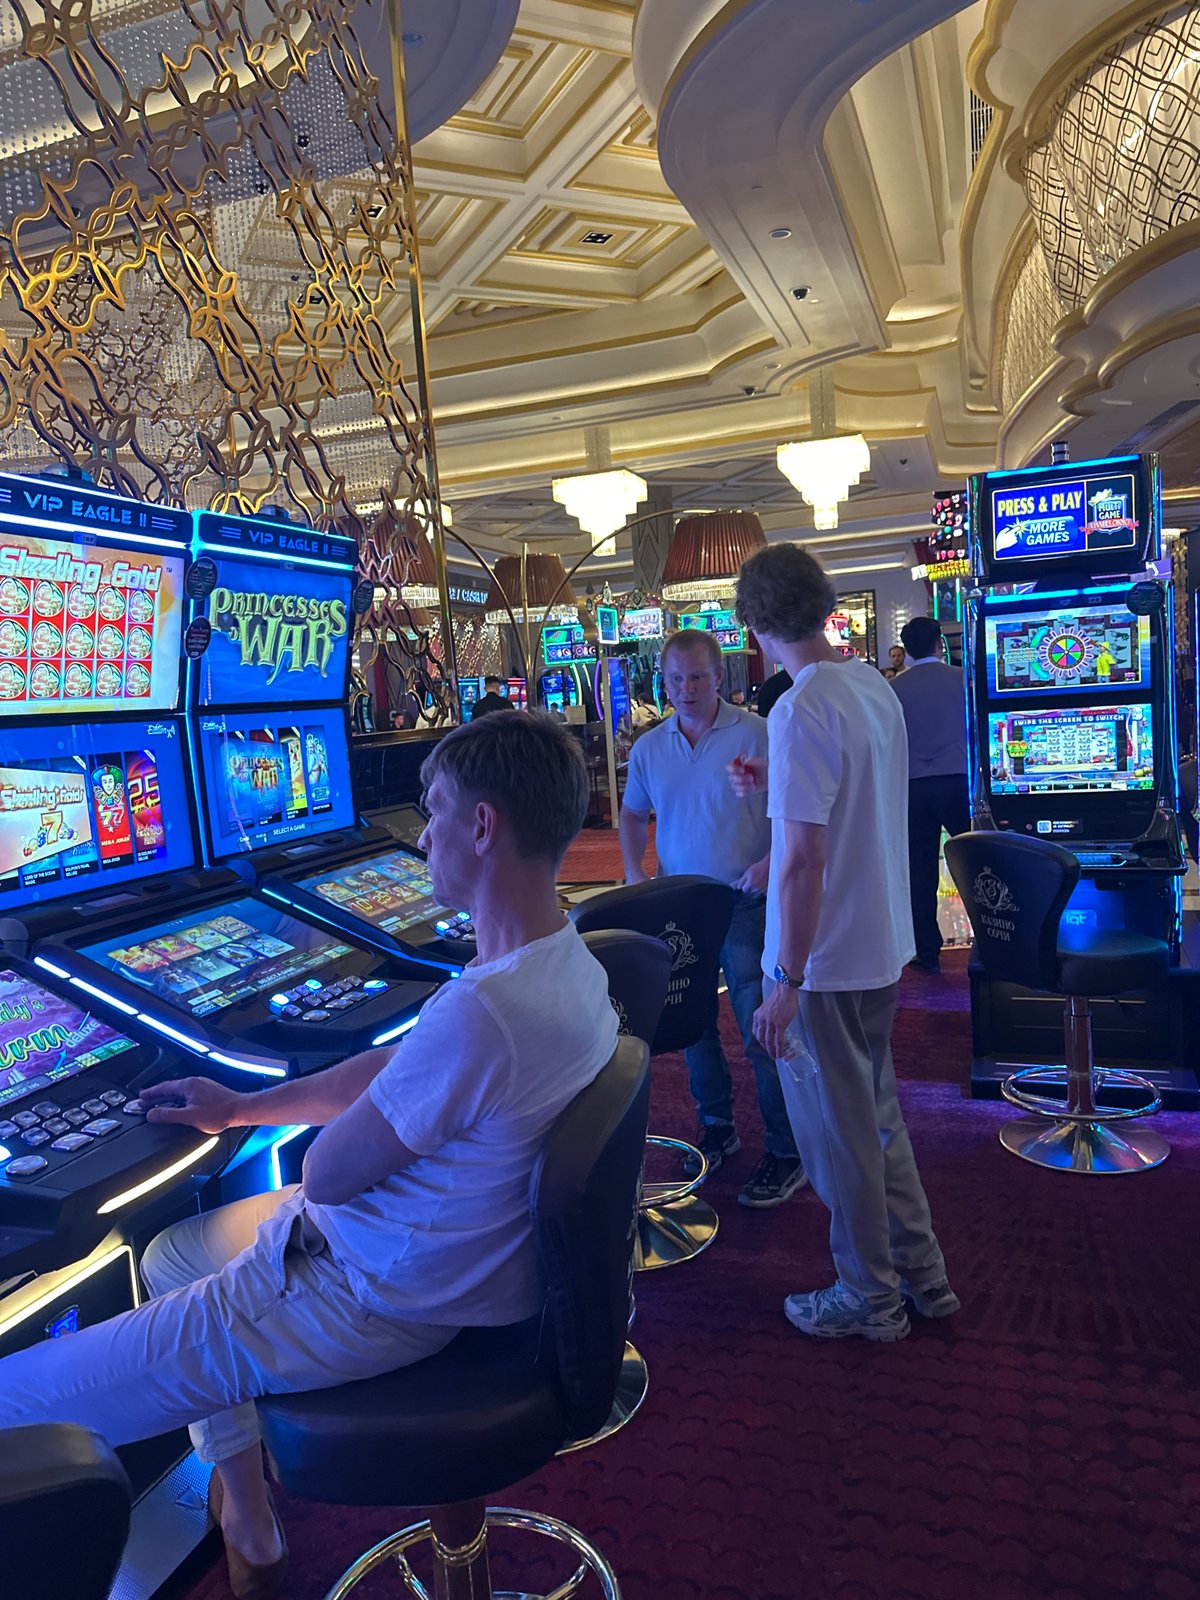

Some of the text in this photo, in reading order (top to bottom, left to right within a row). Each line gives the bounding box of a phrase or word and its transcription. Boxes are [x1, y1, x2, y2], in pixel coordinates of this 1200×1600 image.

[24, 491, 63, 512] VIP
[71, 500, 132, 525] EAGLE
[997, 490, 1083, 517] PRESS & PLAY
[1097, 502, 1121, 512] MULTI
[1098, 510, 1121, 519] GAME
[1029, 520, 1066, 534] MORE
[248, 530, 274, 545] VIP
[278, 535, 319, 553] EAGLE
[1026, 532, 1070, 546] GAMES
[110, 561, 163, 591] Gold
[209, 587, 347, 637] PRINCESSES
[235, 614, 334, 686] WAR
[1013, 718, 1037, 726] SWIPE
[1038, 717, 1053, 725] THE
[1054, 716, 1082, 724] SCREEN
[1095, 714, 1124, 722] SWITCH
[980, 913, 1016, 932] КАЗИНО
[987, 926, 1011, 942] СОЧИ
[667, 976, 690, 992] ИНО
[664, 992, 683, 1006] ЧИ
